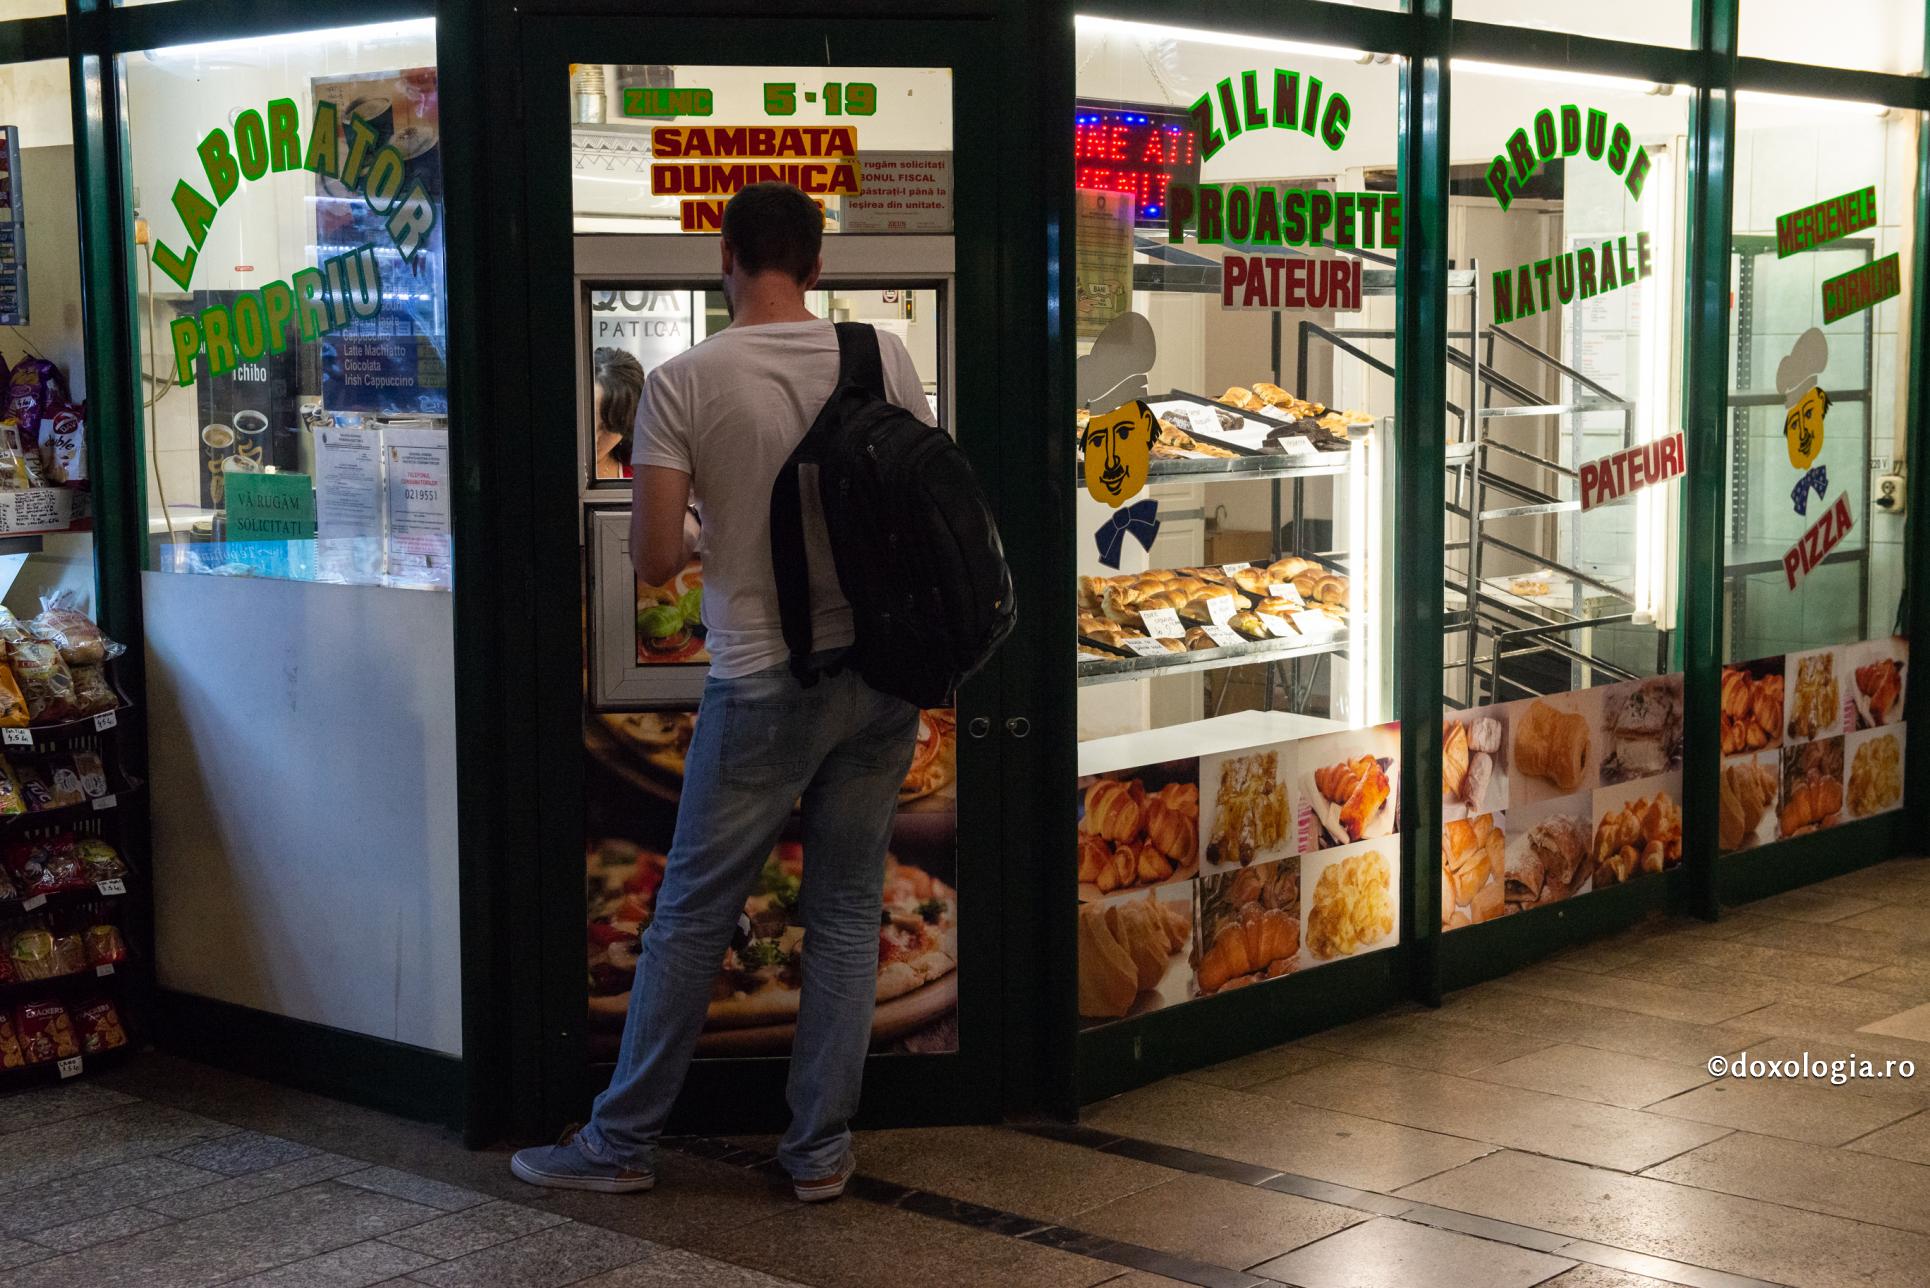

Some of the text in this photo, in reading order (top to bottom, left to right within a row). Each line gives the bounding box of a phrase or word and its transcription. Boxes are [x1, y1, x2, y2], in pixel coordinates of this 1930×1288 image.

[626, 90, 711, 114] ZILNIC
[1187, 68, 1351, 163] ZILNIC
[654, 128, 855, 157] SAMBATA
[864, 160, 897, 170] rugăm
[1485, 104, 1652, 211] PRODUSE
[898, 173, 936, 182] FISCAL
[152, 97, 437, 292] LABORATOR
[937, 187, 946, 195] la
[887, 200, 903, 209] din
[1168, 183, 1401, 249] PROASPETE
[1777, 187, 1877, 257] MERDENELE
[1223, 256, 1361, 309] PATEURI
[1492, 230, 1652, 325] NATURALE
[1824, 256, 1900, 321] CORNURI
[170, 242, 382, 388] PROPRIU
[343, 329, 391, 343] Cappuccino
[344, 344, 406, 357] Latte Machiatto
[344, 359, 381, 371] Ciocolata
[345, 374, 414, 389] Irish Cappuccino
[1580, 432, 1685, 509] PATEURI
[257, 493, 300, 510] RUGĂM
[404, 489, 438, 501] 0219551
[1784, 496, 1853, 591] PIZZA
[27, 780, 52, 802] TUC
